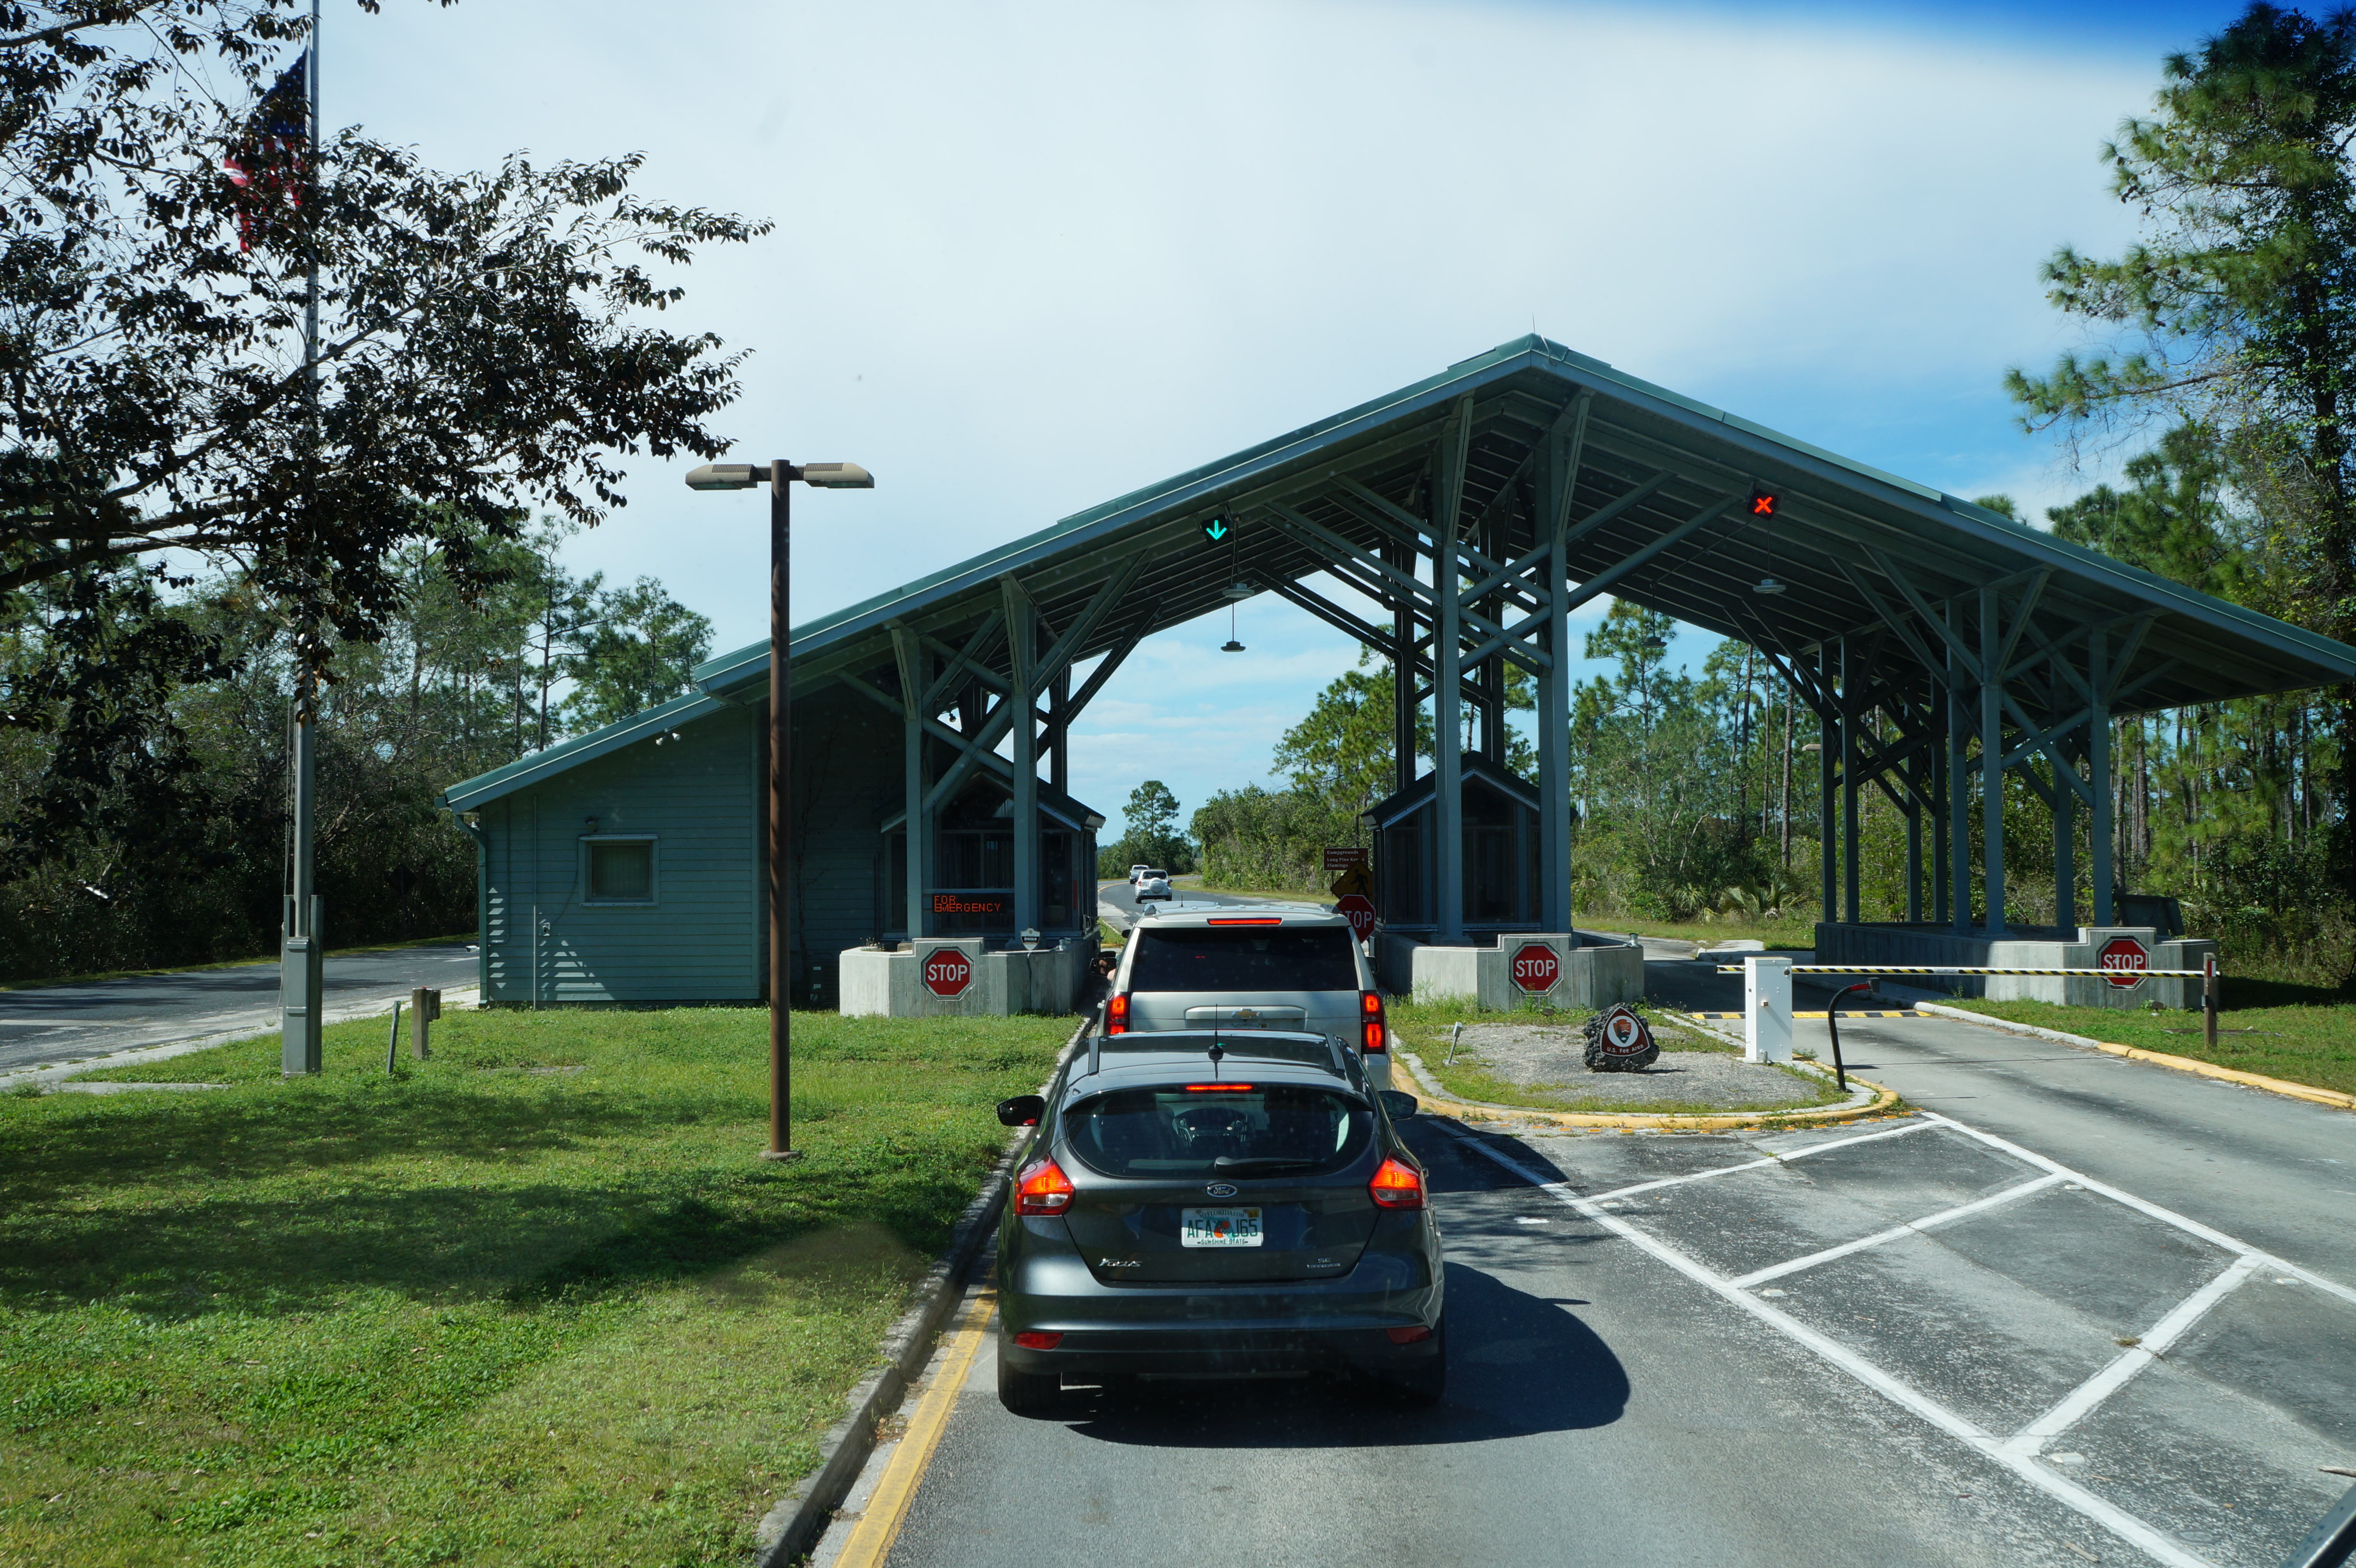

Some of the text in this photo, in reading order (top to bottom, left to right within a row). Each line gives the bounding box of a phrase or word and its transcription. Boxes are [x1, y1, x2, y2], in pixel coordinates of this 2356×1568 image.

[934, 903, 1001, 912] EMERGENCY
[1340, 910, 1373, 928] TOP
[1515, 960, 1555, 977] STOP
[2103, 954, 2144, 970] STOP
[928, 964, 968, 981] STOP
[1187, 1219, 1257, 1238] AFA J65
